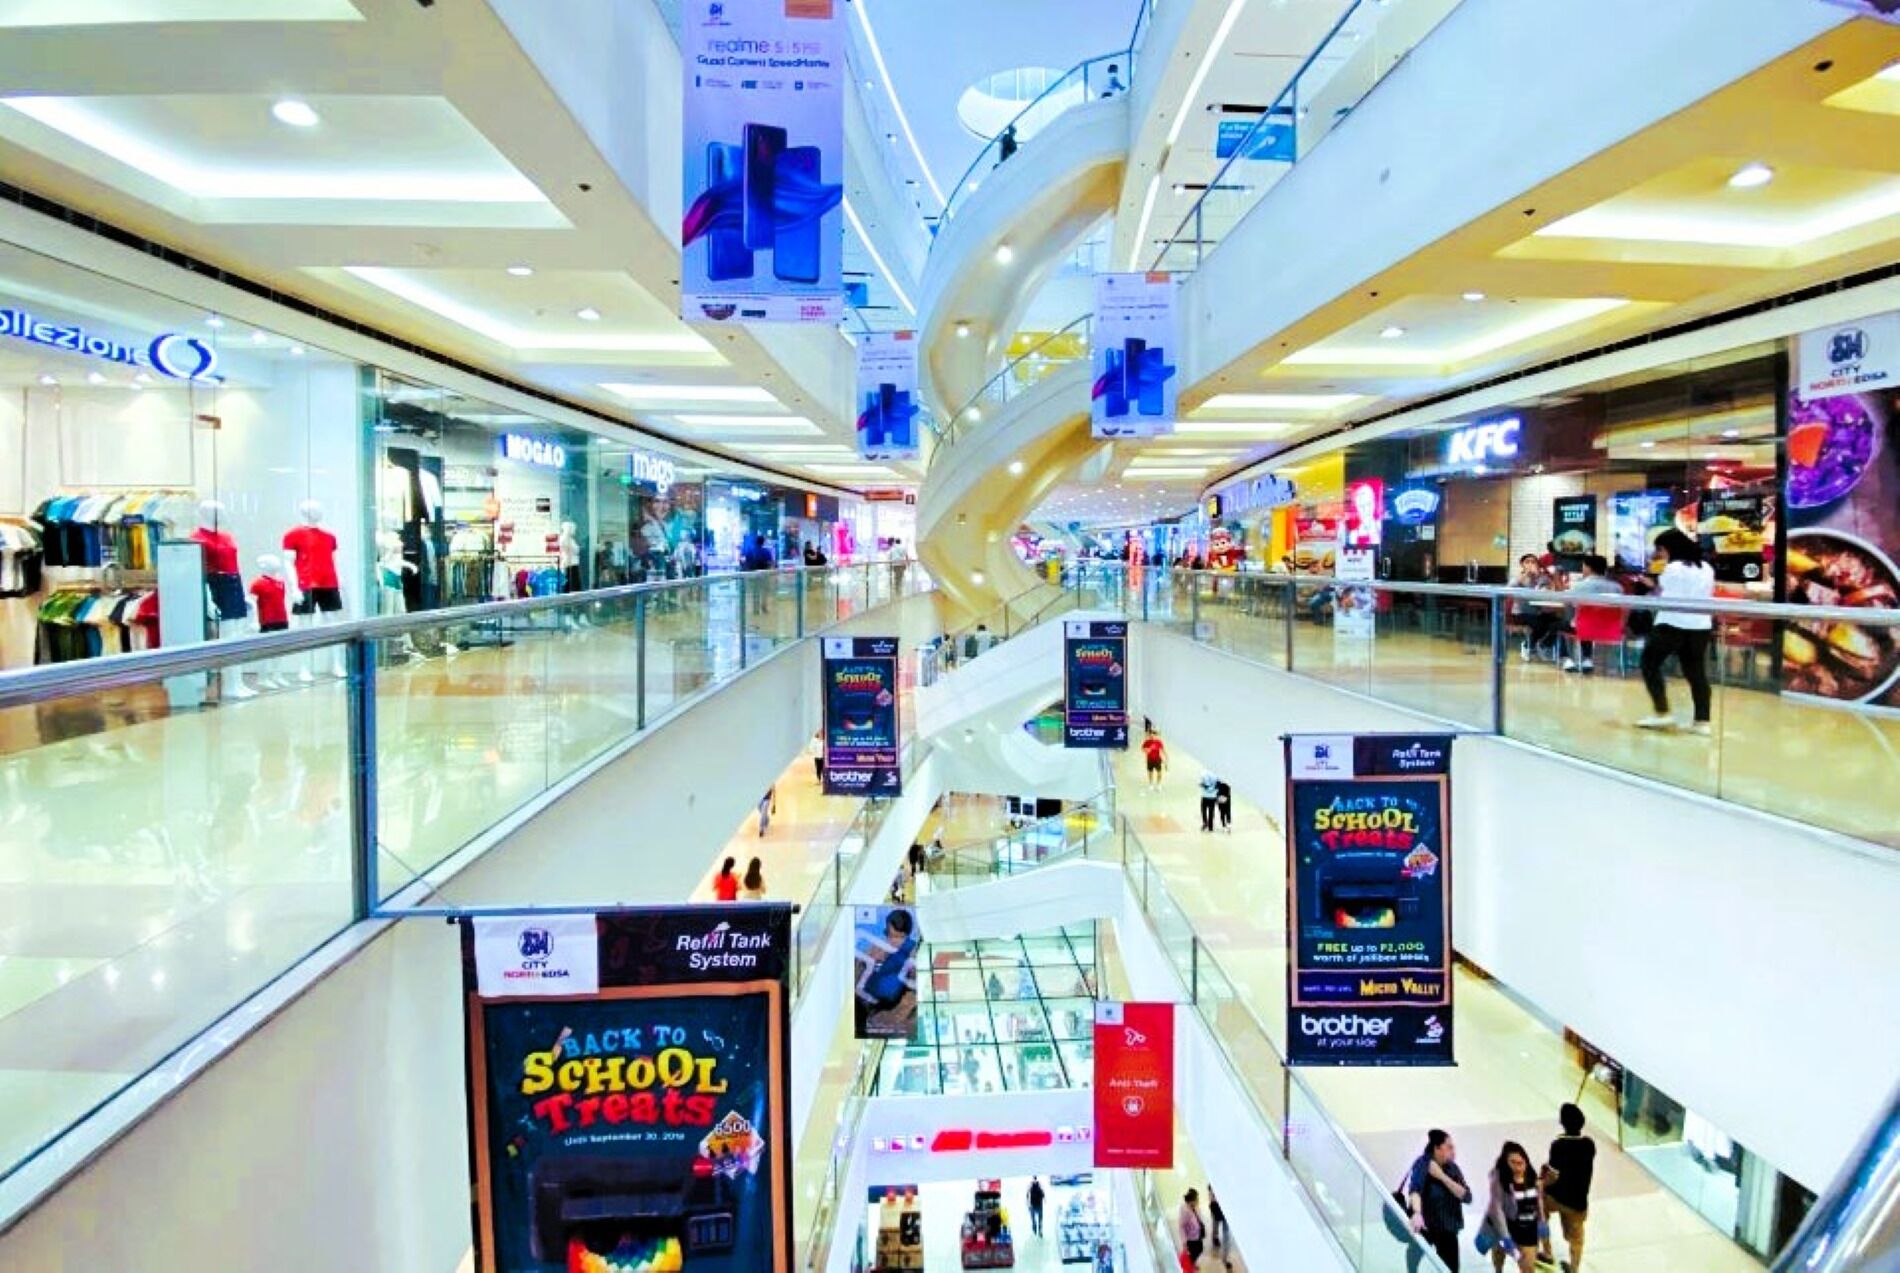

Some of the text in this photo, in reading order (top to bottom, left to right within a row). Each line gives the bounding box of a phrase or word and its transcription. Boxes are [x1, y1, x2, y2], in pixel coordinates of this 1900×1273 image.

[708, 37, 769, 53] realme
[1831, 366, 1861, 378] CITY
[1450, 417, 1520, 464] KFC
[507, 433, 565, 468] MOGAO
[1069, 727, 1106, 738] brother
[829, 770, 873, 783] brother
[676, 932, 771, 950] Refill Tank
[1317, 943, 1348, 953] FREE
[521, 961, 549, 969] CITY
[690, 952, 757, 970] System
[1301, 1014, 1394, 1036] brother
[562, 1025, 687, 1058] BACK TO
[532, 1087, 718, 1134] Treats
[590, 1132, 642, 1144] September
